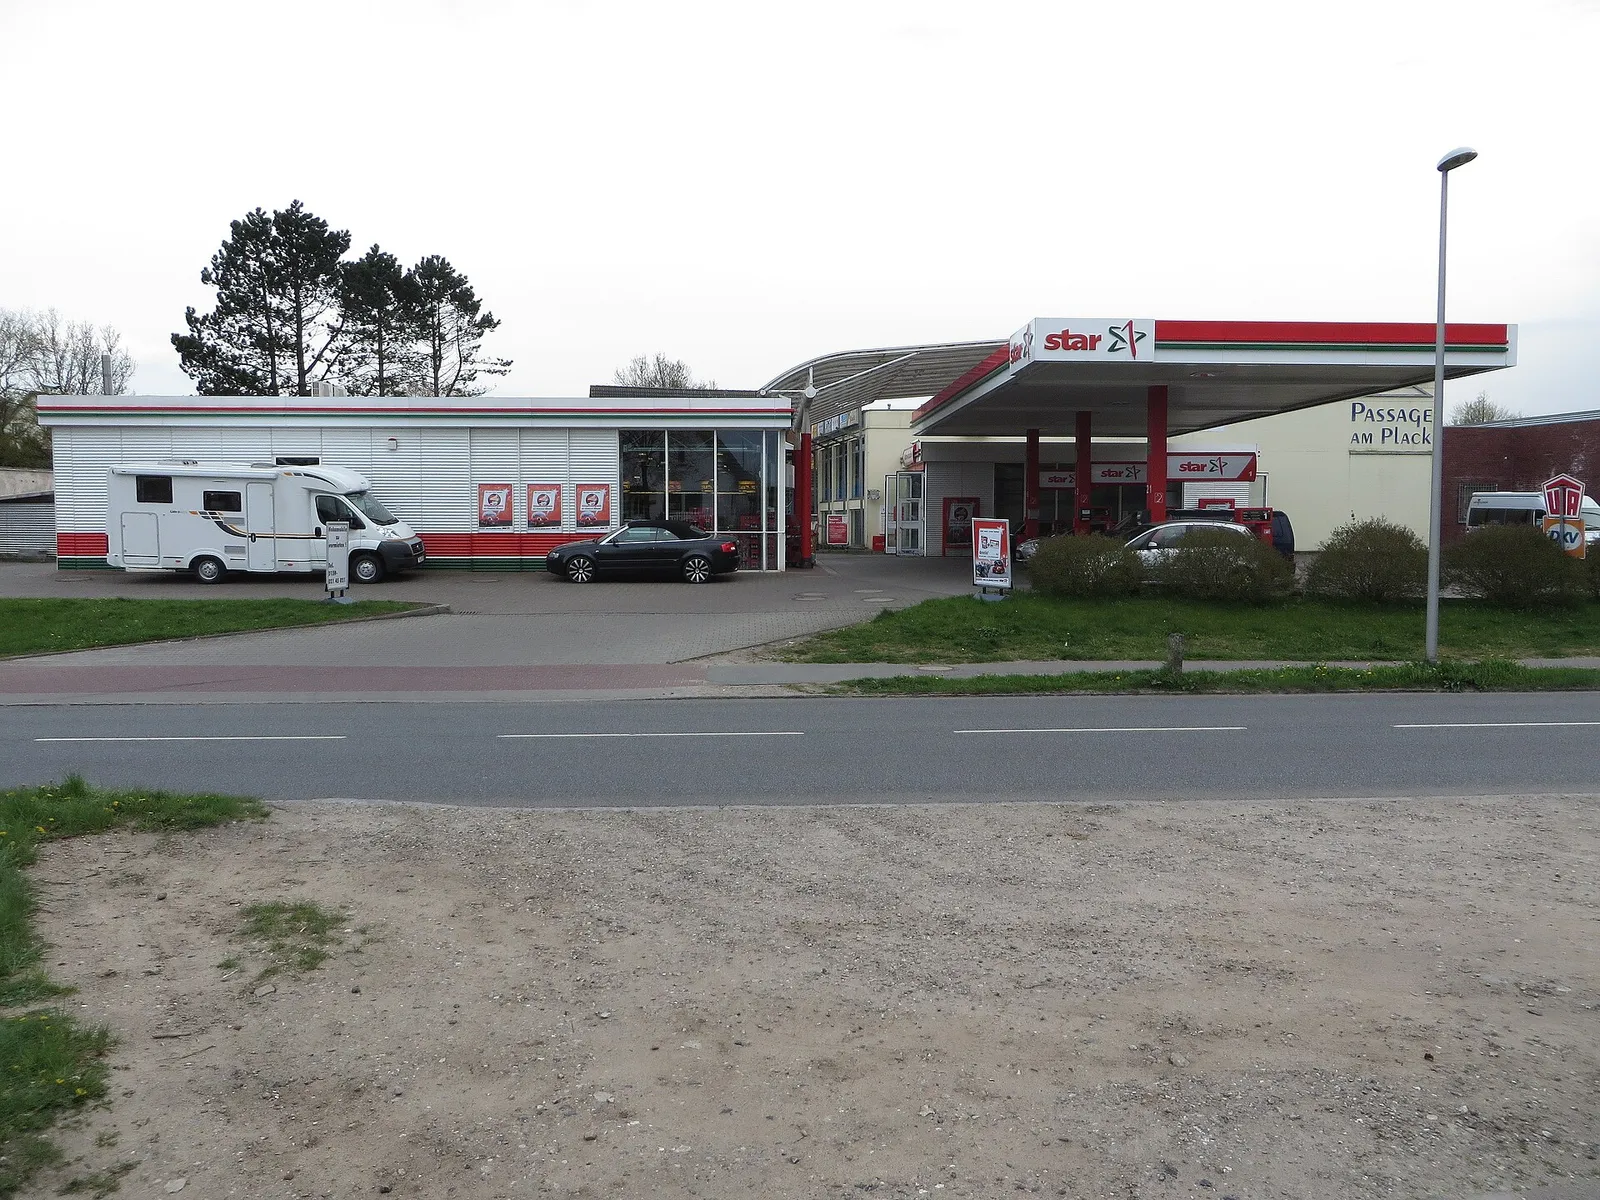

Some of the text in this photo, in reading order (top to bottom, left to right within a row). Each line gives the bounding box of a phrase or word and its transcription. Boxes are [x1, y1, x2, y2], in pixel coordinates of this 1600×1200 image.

[1044, 328, 1102, 351] star
[1351, 402, 1433, 428] PASSAGE
[1100, 468, 1125, 478] star
[1178, 461, 1208, 473] star
[1047, 475, 1068, 484] star
